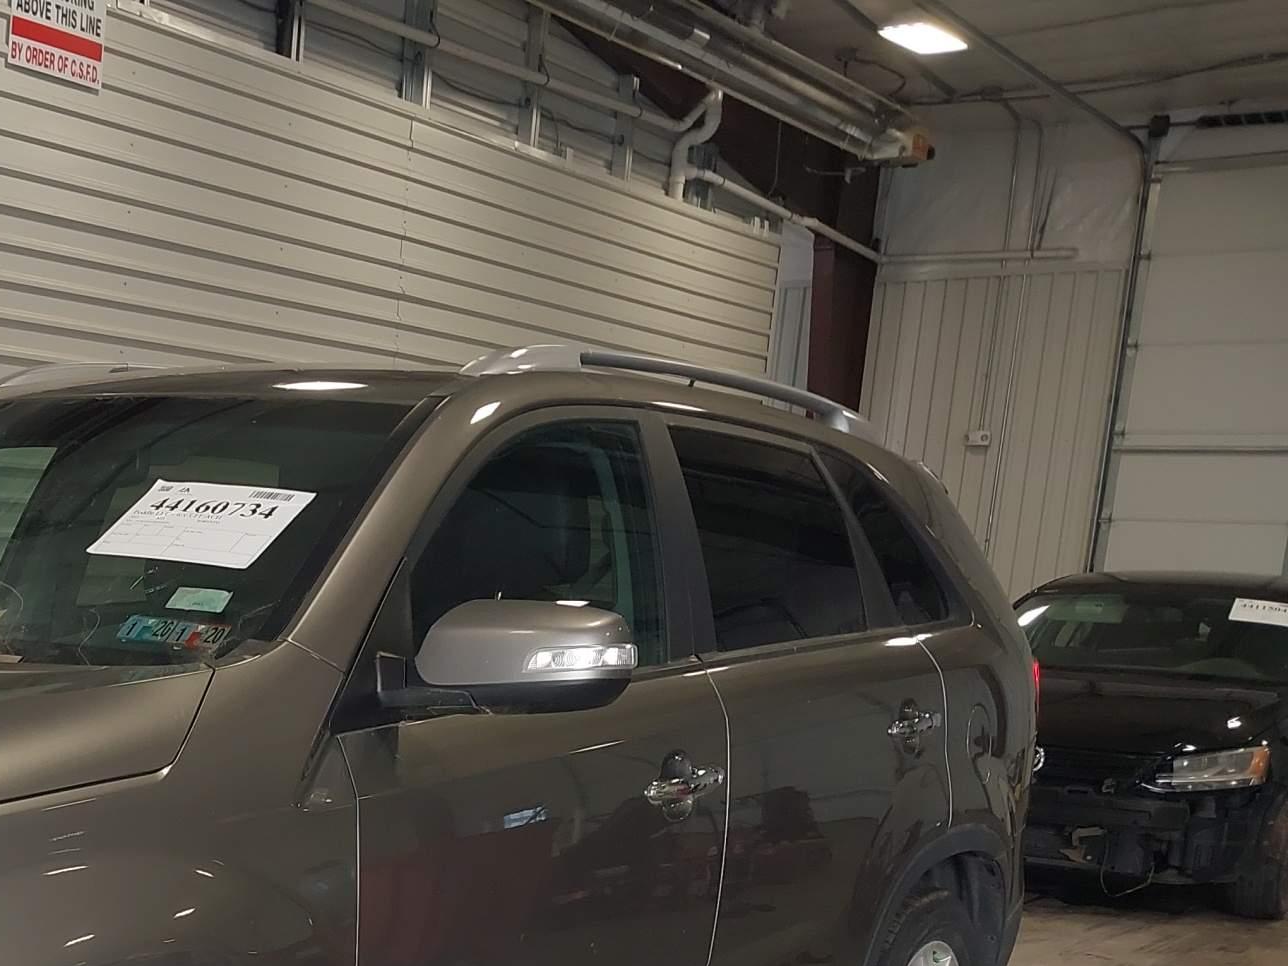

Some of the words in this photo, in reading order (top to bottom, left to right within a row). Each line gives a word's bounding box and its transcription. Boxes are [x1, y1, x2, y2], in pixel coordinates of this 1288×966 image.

[16, 0, 52, 20] ABOVE
[55, 4, 78, 29] THIS
[79, 13, 102, 37] LINE
[11, 41, 23, 62] BY
[25, 45, 55, 71] ORDER
[57, 55, 68, 74] OF
[70, 59, 100, 85] C.S.F.D.
[150, 496, 279, 520] 44160734
